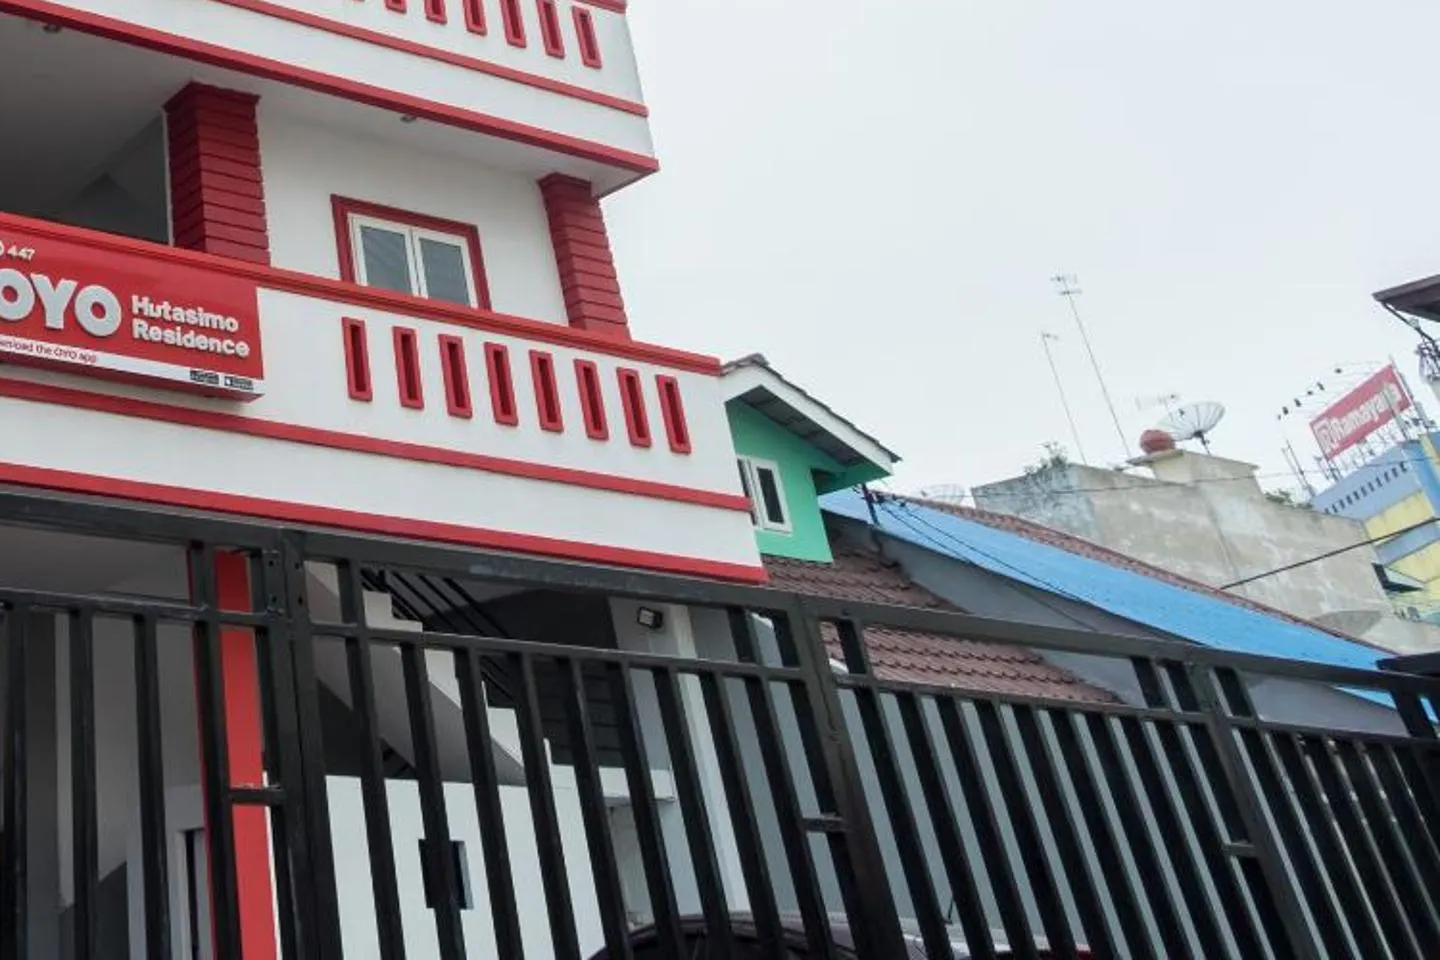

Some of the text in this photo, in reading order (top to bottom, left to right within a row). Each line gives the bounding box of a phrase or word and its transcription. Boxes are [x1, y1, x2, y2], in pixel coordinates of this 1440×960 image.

[6, 244, 36, 262] 447
[131, 294, 240, 333] Hutasimo
[36, 343, 53, 355] the
[53, 347, 78, 360] OYO
[132, 318, 250, 358] Residence
